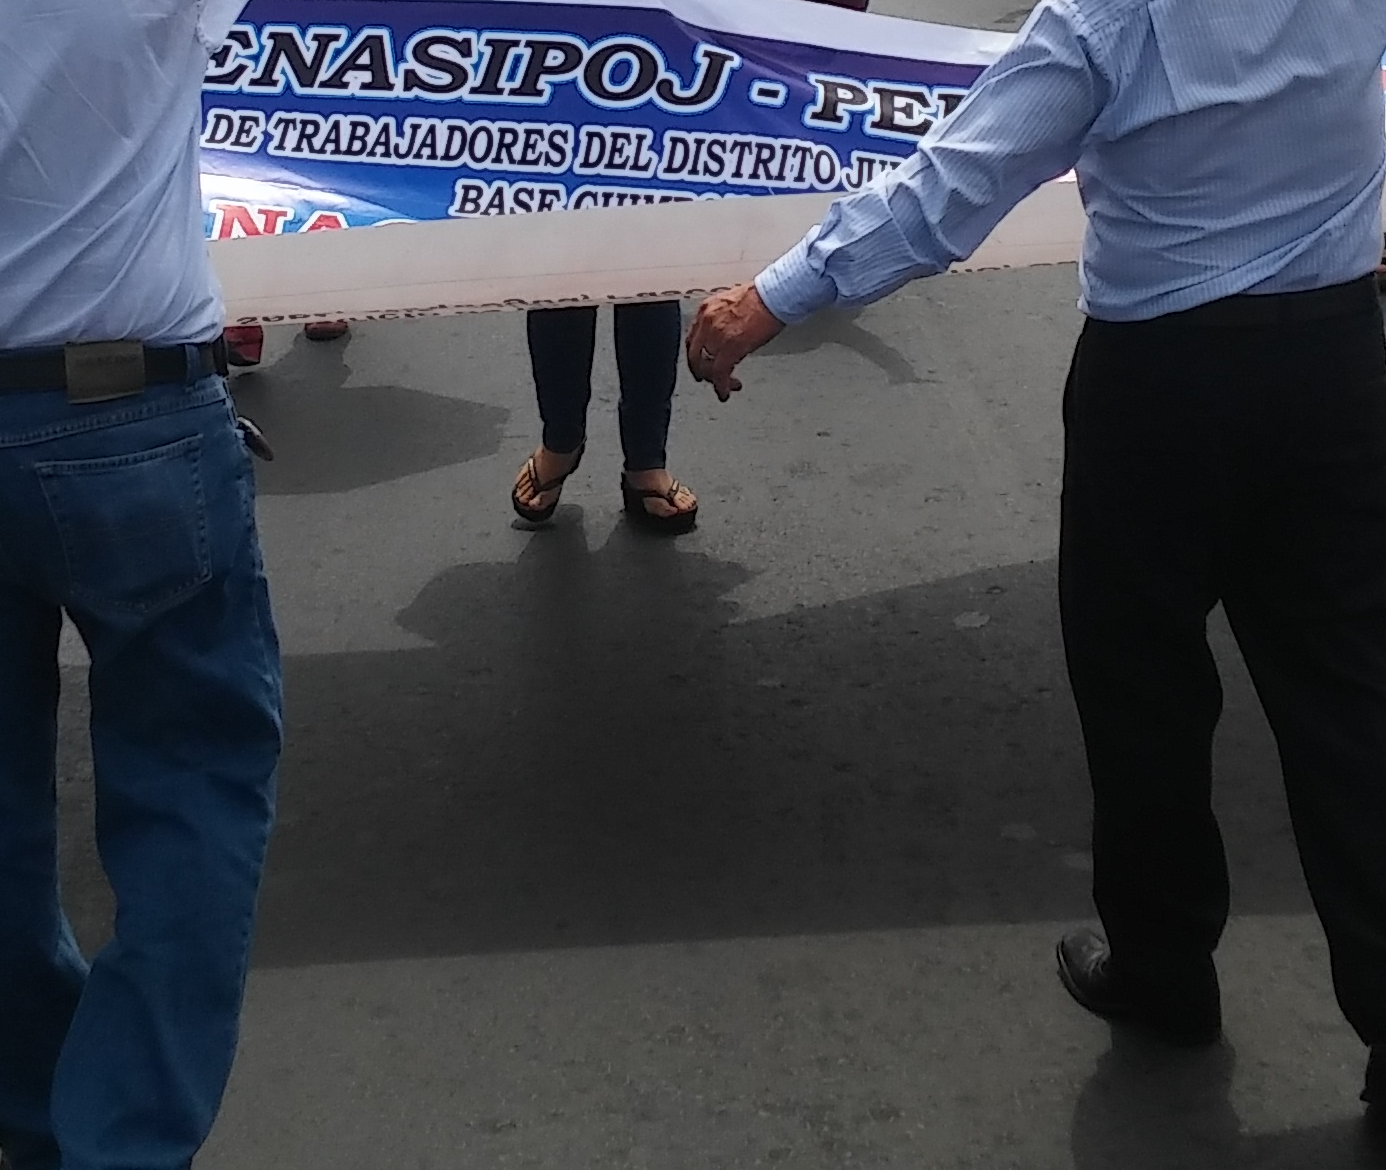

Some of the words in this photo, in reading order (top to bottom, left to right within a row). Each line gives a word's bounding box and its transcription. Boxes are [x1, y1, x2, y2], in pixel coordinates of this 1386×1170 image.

[205, 113, 260, 149] DE
[273, 117, 568, 169] TRABAJADORES
[579, 130, 654, 173] DEL
[662, 136, 837, 186] DISTRITO
